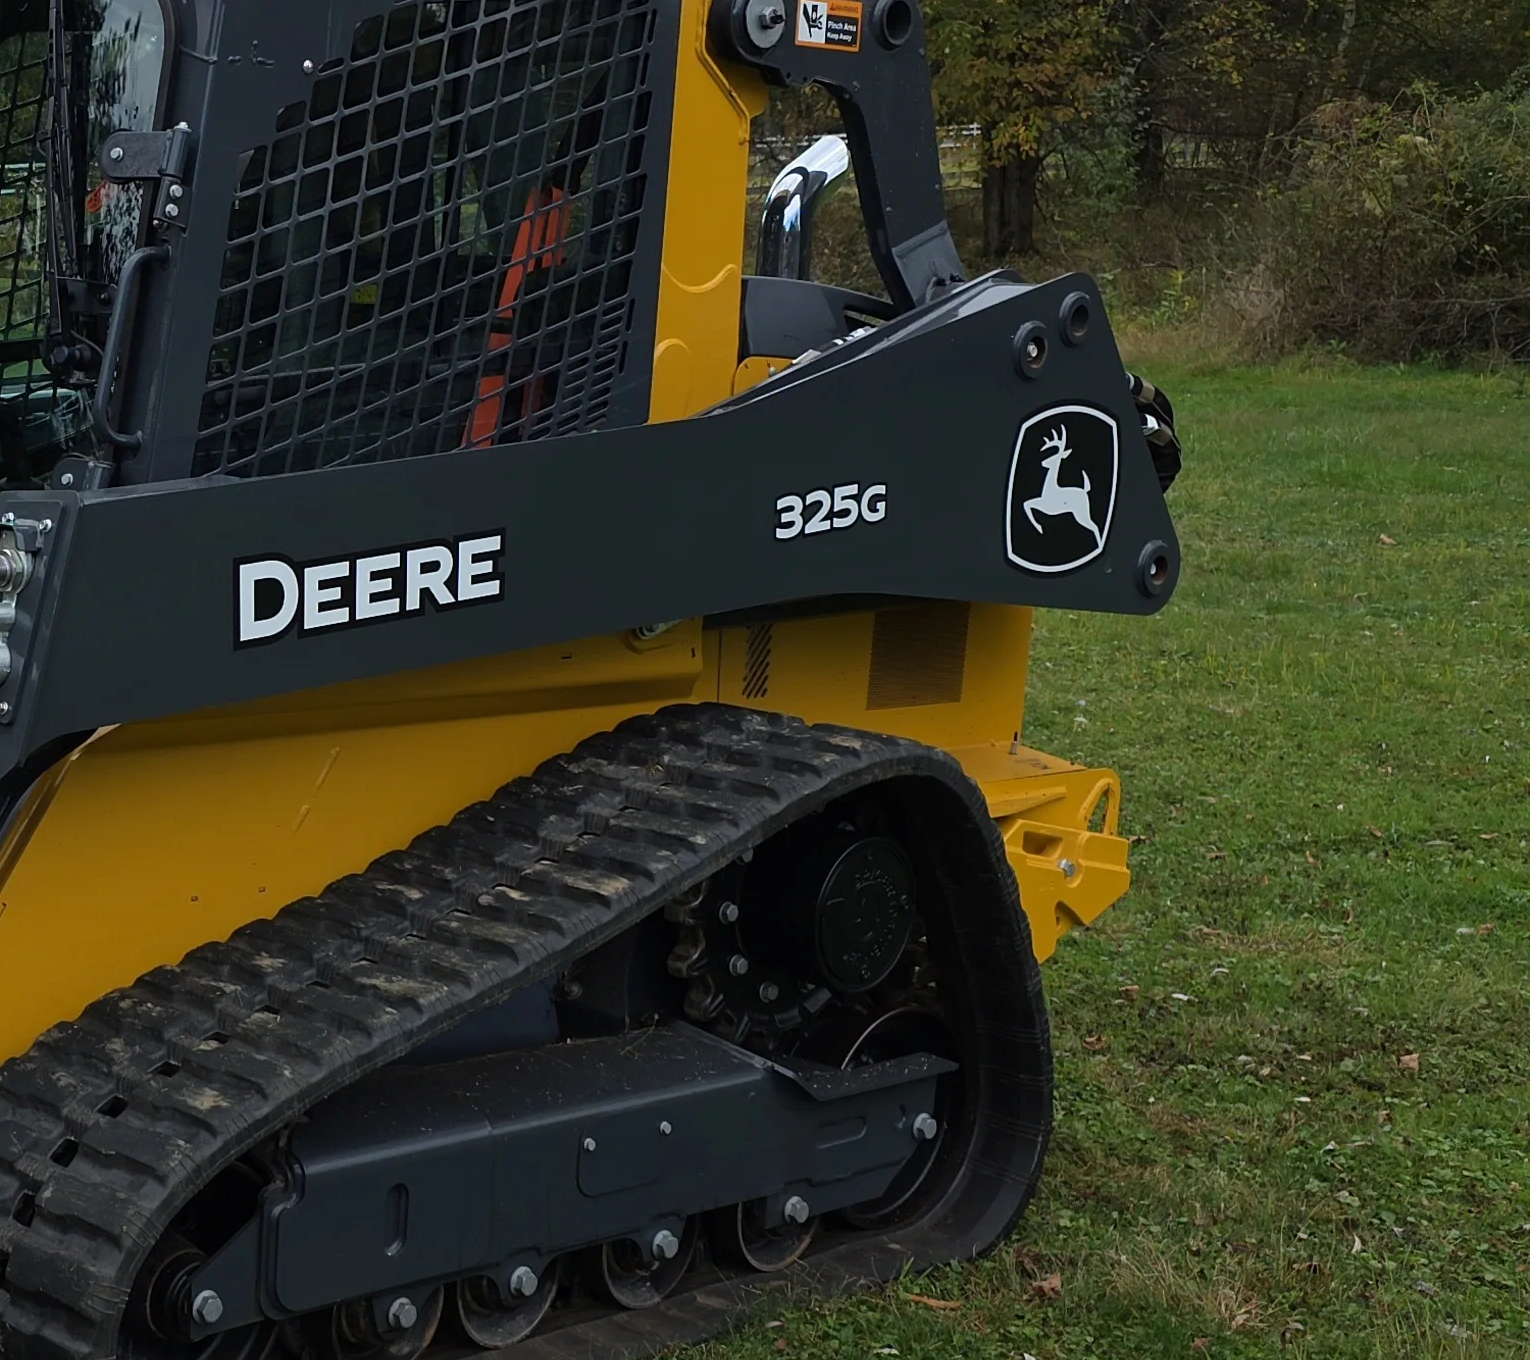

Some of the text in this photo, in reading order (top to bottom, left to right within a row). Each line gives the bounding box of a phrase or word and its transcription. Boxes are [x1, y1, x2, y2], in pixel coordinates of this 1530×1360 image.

[828, 21, 857, 32] Pinch Area
[775, 483, 887, 539] 325G
[239, 534, 502, 642] DEERE
